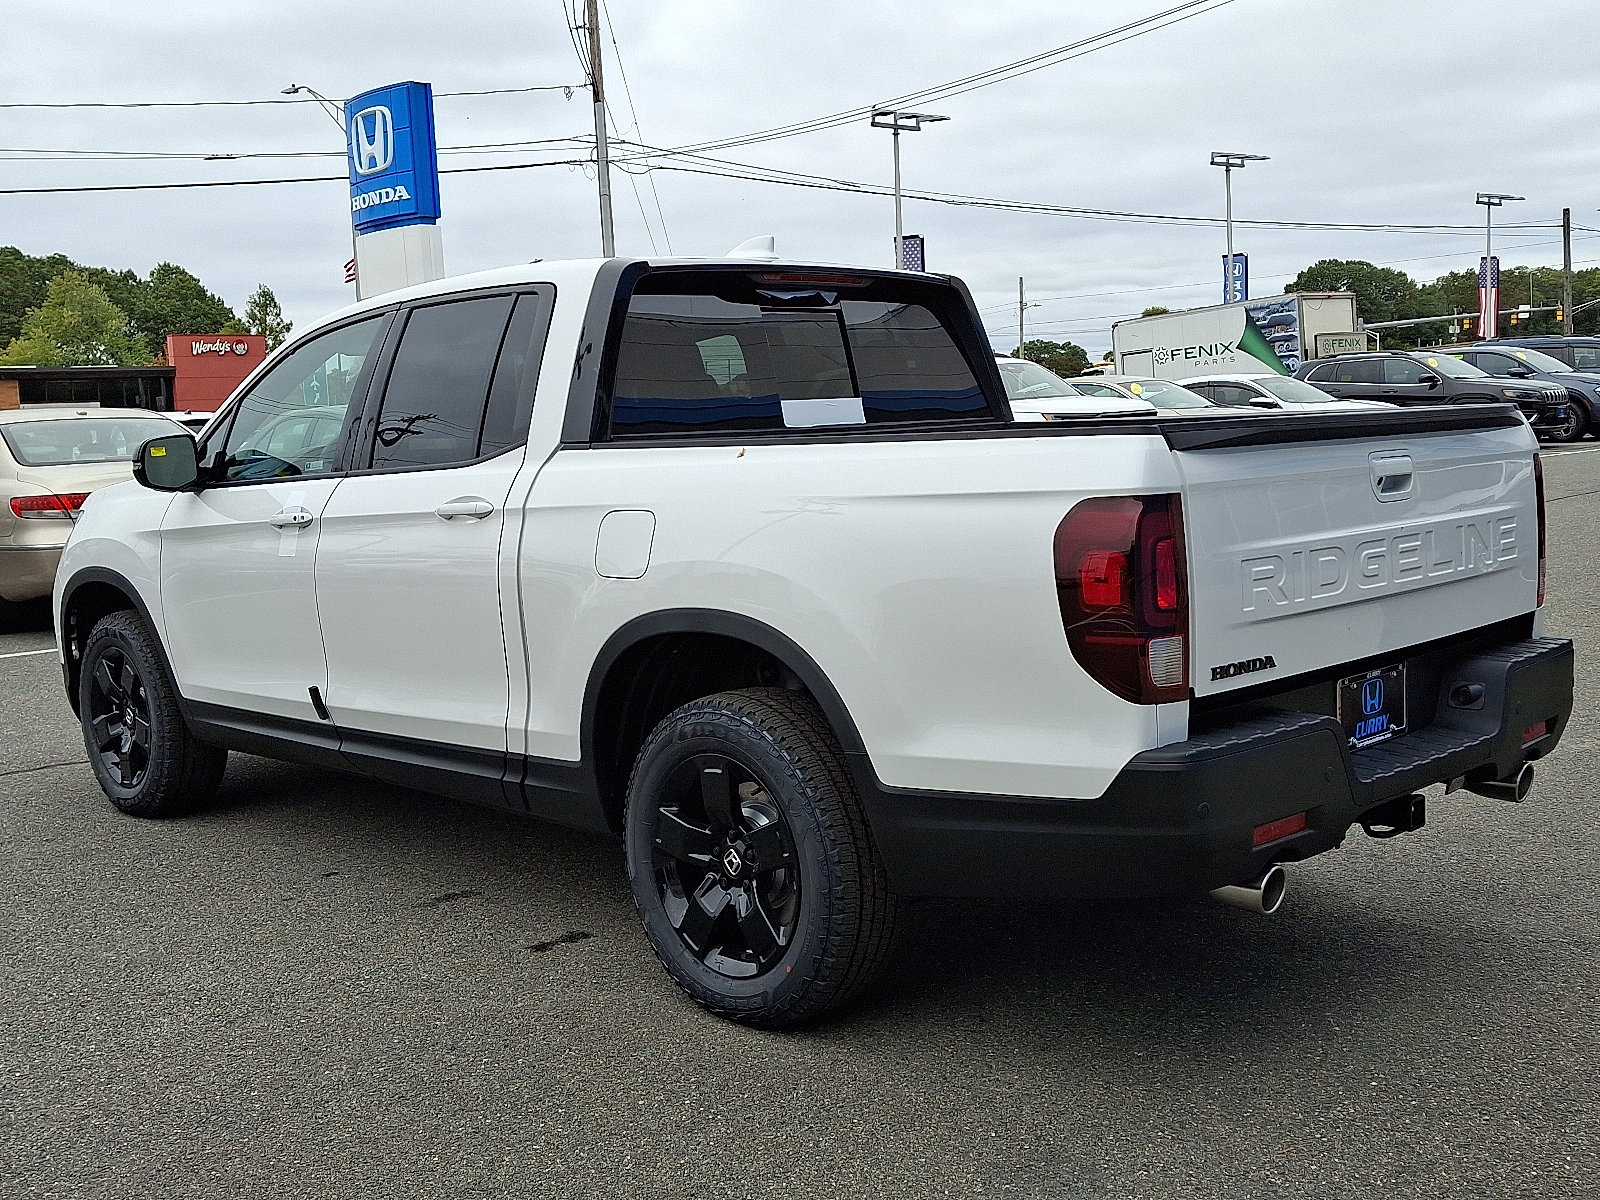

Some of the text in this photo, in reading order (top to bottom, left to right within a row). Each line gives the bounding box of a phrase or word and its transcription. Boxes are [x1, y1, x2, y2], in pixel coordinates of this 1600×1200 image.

[352, 185, 411, 212] HONDA
[191, 338, 231, 355] Wendy's
[1170, 341, 1235, 361] FENIX
[1331, 338, 1362, 348] FENIX
[1194, 356, 1236, 367] PARTS
[1240, 516, 1518, 611] RIDGELINE
[1210, 655, 1277, 681] HONDA
[1355, 713, 1390, 739] CURRY
